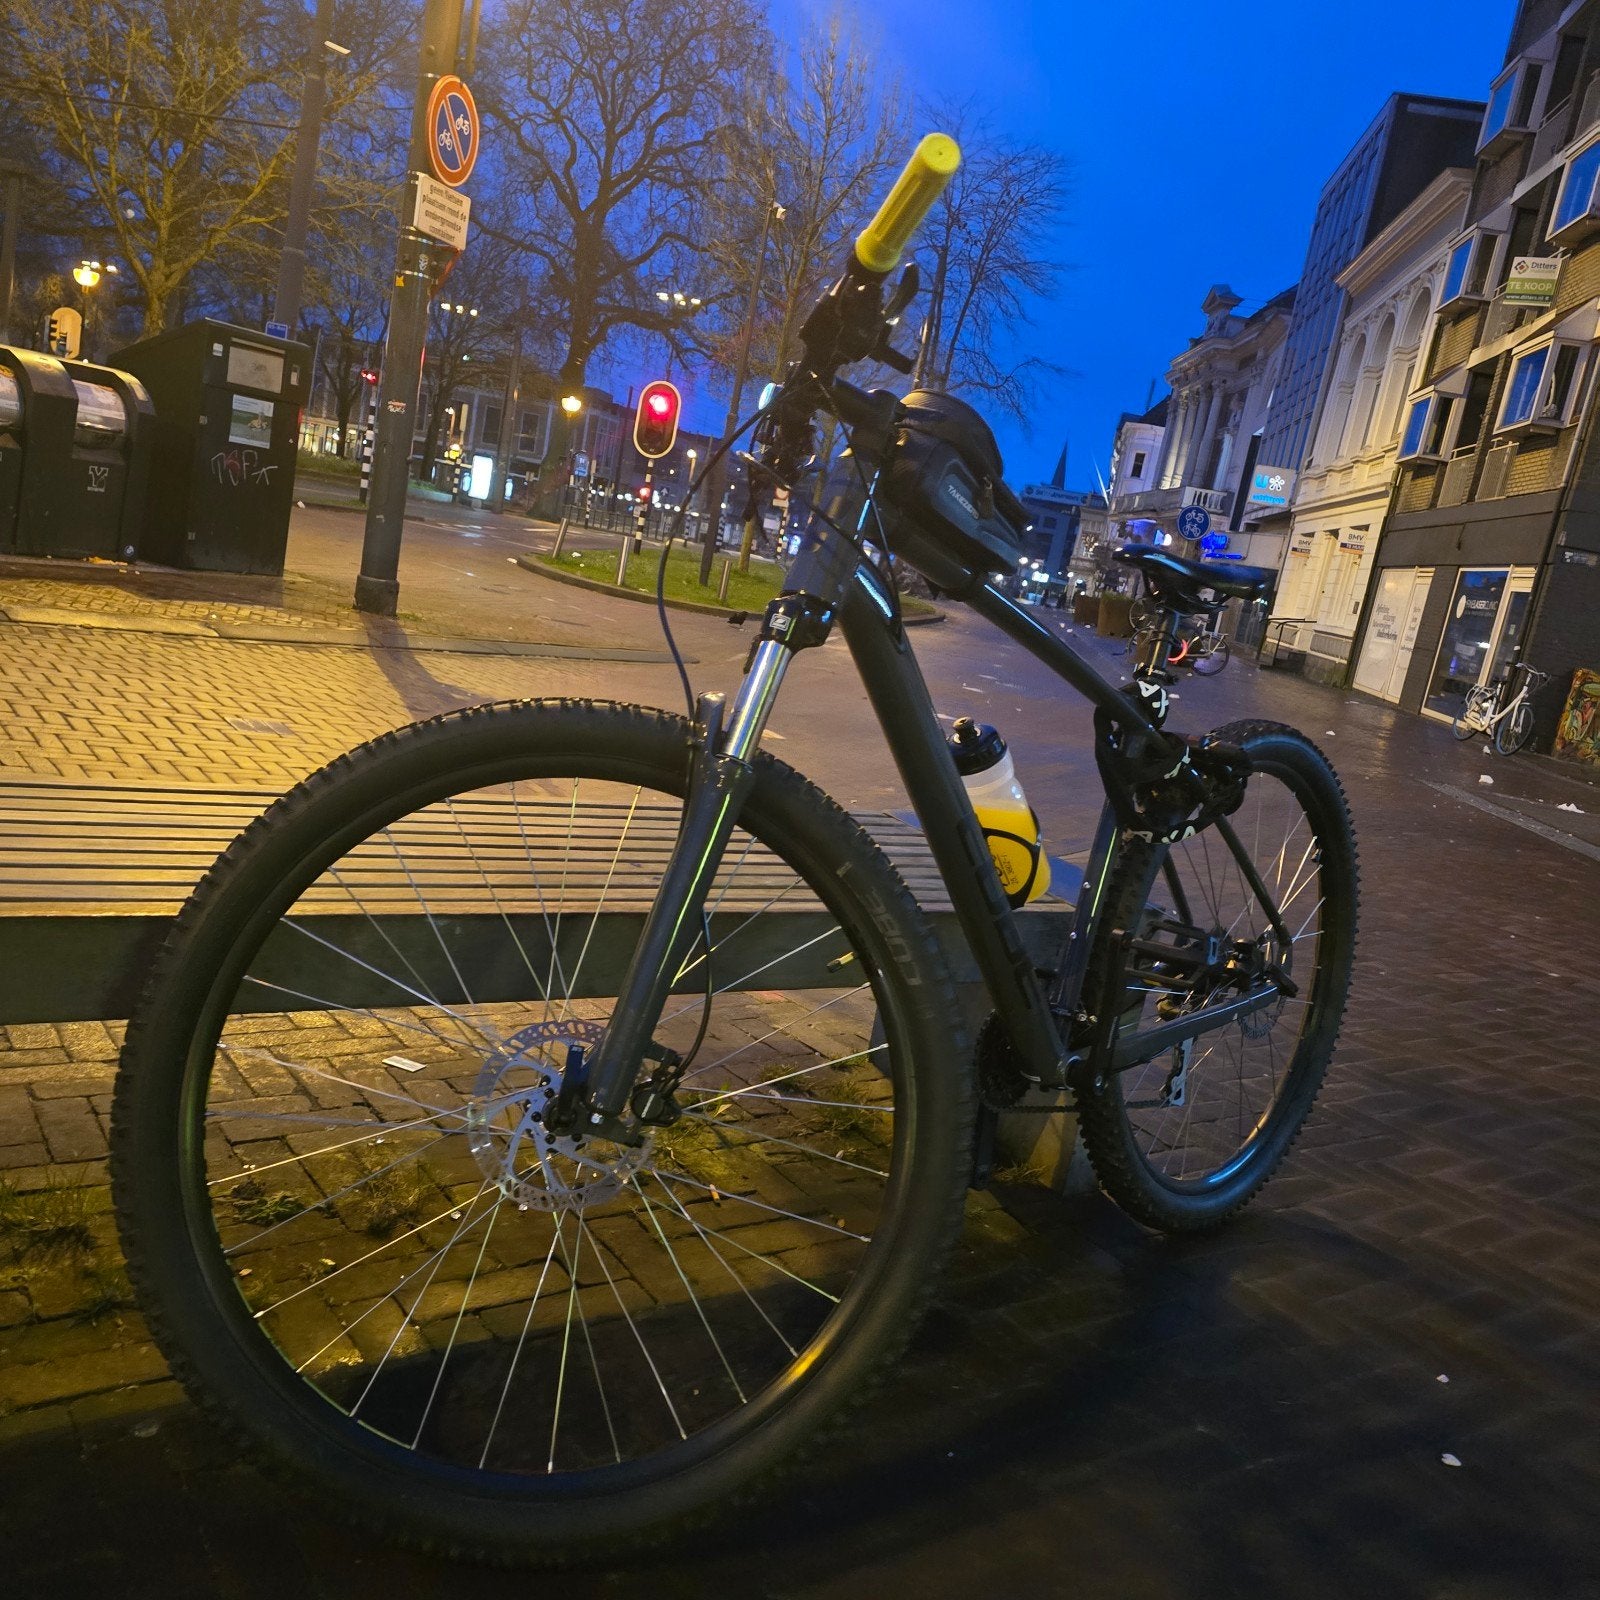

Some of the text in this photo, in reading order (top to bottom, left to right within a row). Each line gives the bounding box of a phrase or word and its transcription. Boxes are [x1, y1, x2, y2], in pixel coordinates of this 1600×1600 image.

[1531, 262, 1557, 270] Ditters
[1510, 282, 1553, 291] TE KOOP
